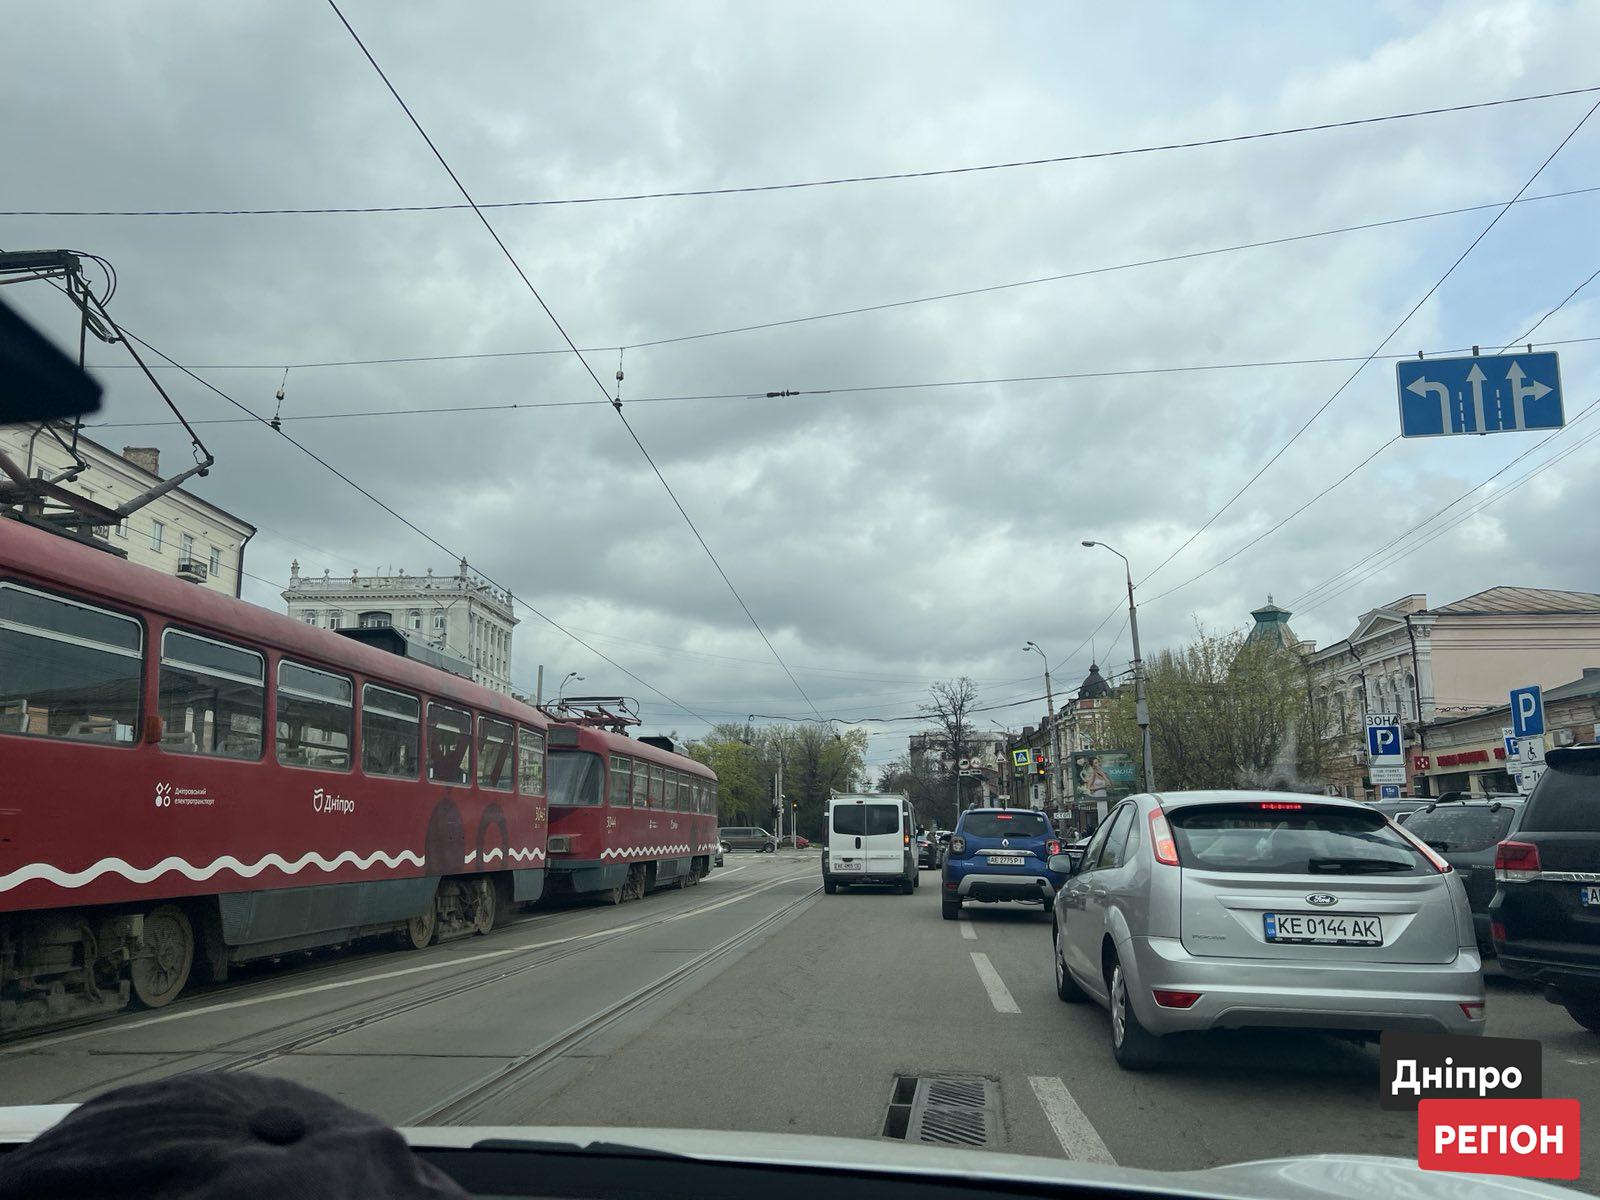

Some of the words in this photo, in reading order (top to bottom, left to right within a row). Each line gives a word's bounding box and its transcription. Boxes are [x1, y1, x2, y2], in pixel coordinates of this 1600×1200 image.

[1366, 716, 1400, 725] ЗОНА
[1518, 693, 1536, 731] P
[1376, 729, 1394, 753] P
[323, 795, 355, 814] Дніпро
[1313, 895, 1331, 904] Ford
[1278, 917, 1303, 934] KE
[1306, 918, 1347, 936] 0144
[1352, 920, 1377, 937] AK
